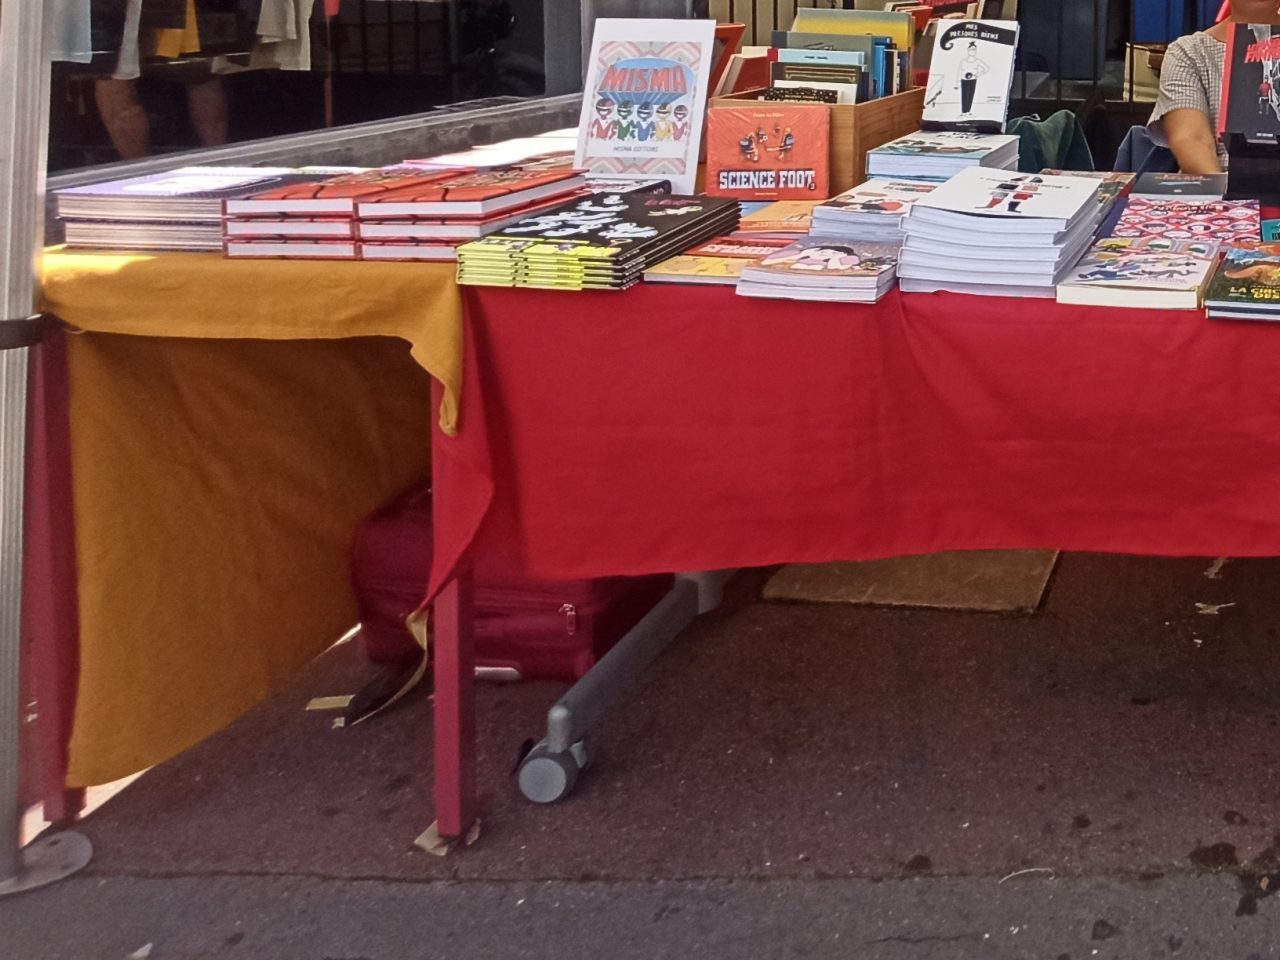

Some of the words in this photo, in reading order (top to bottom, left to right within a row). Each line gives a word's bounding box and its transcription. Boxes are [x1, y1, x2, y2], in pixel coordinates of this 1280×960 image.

[597, 64, 688, 95] MISMA
[719, 171, 776, 189] SCIENCE
[778, 170, 815, 188] FOOT
